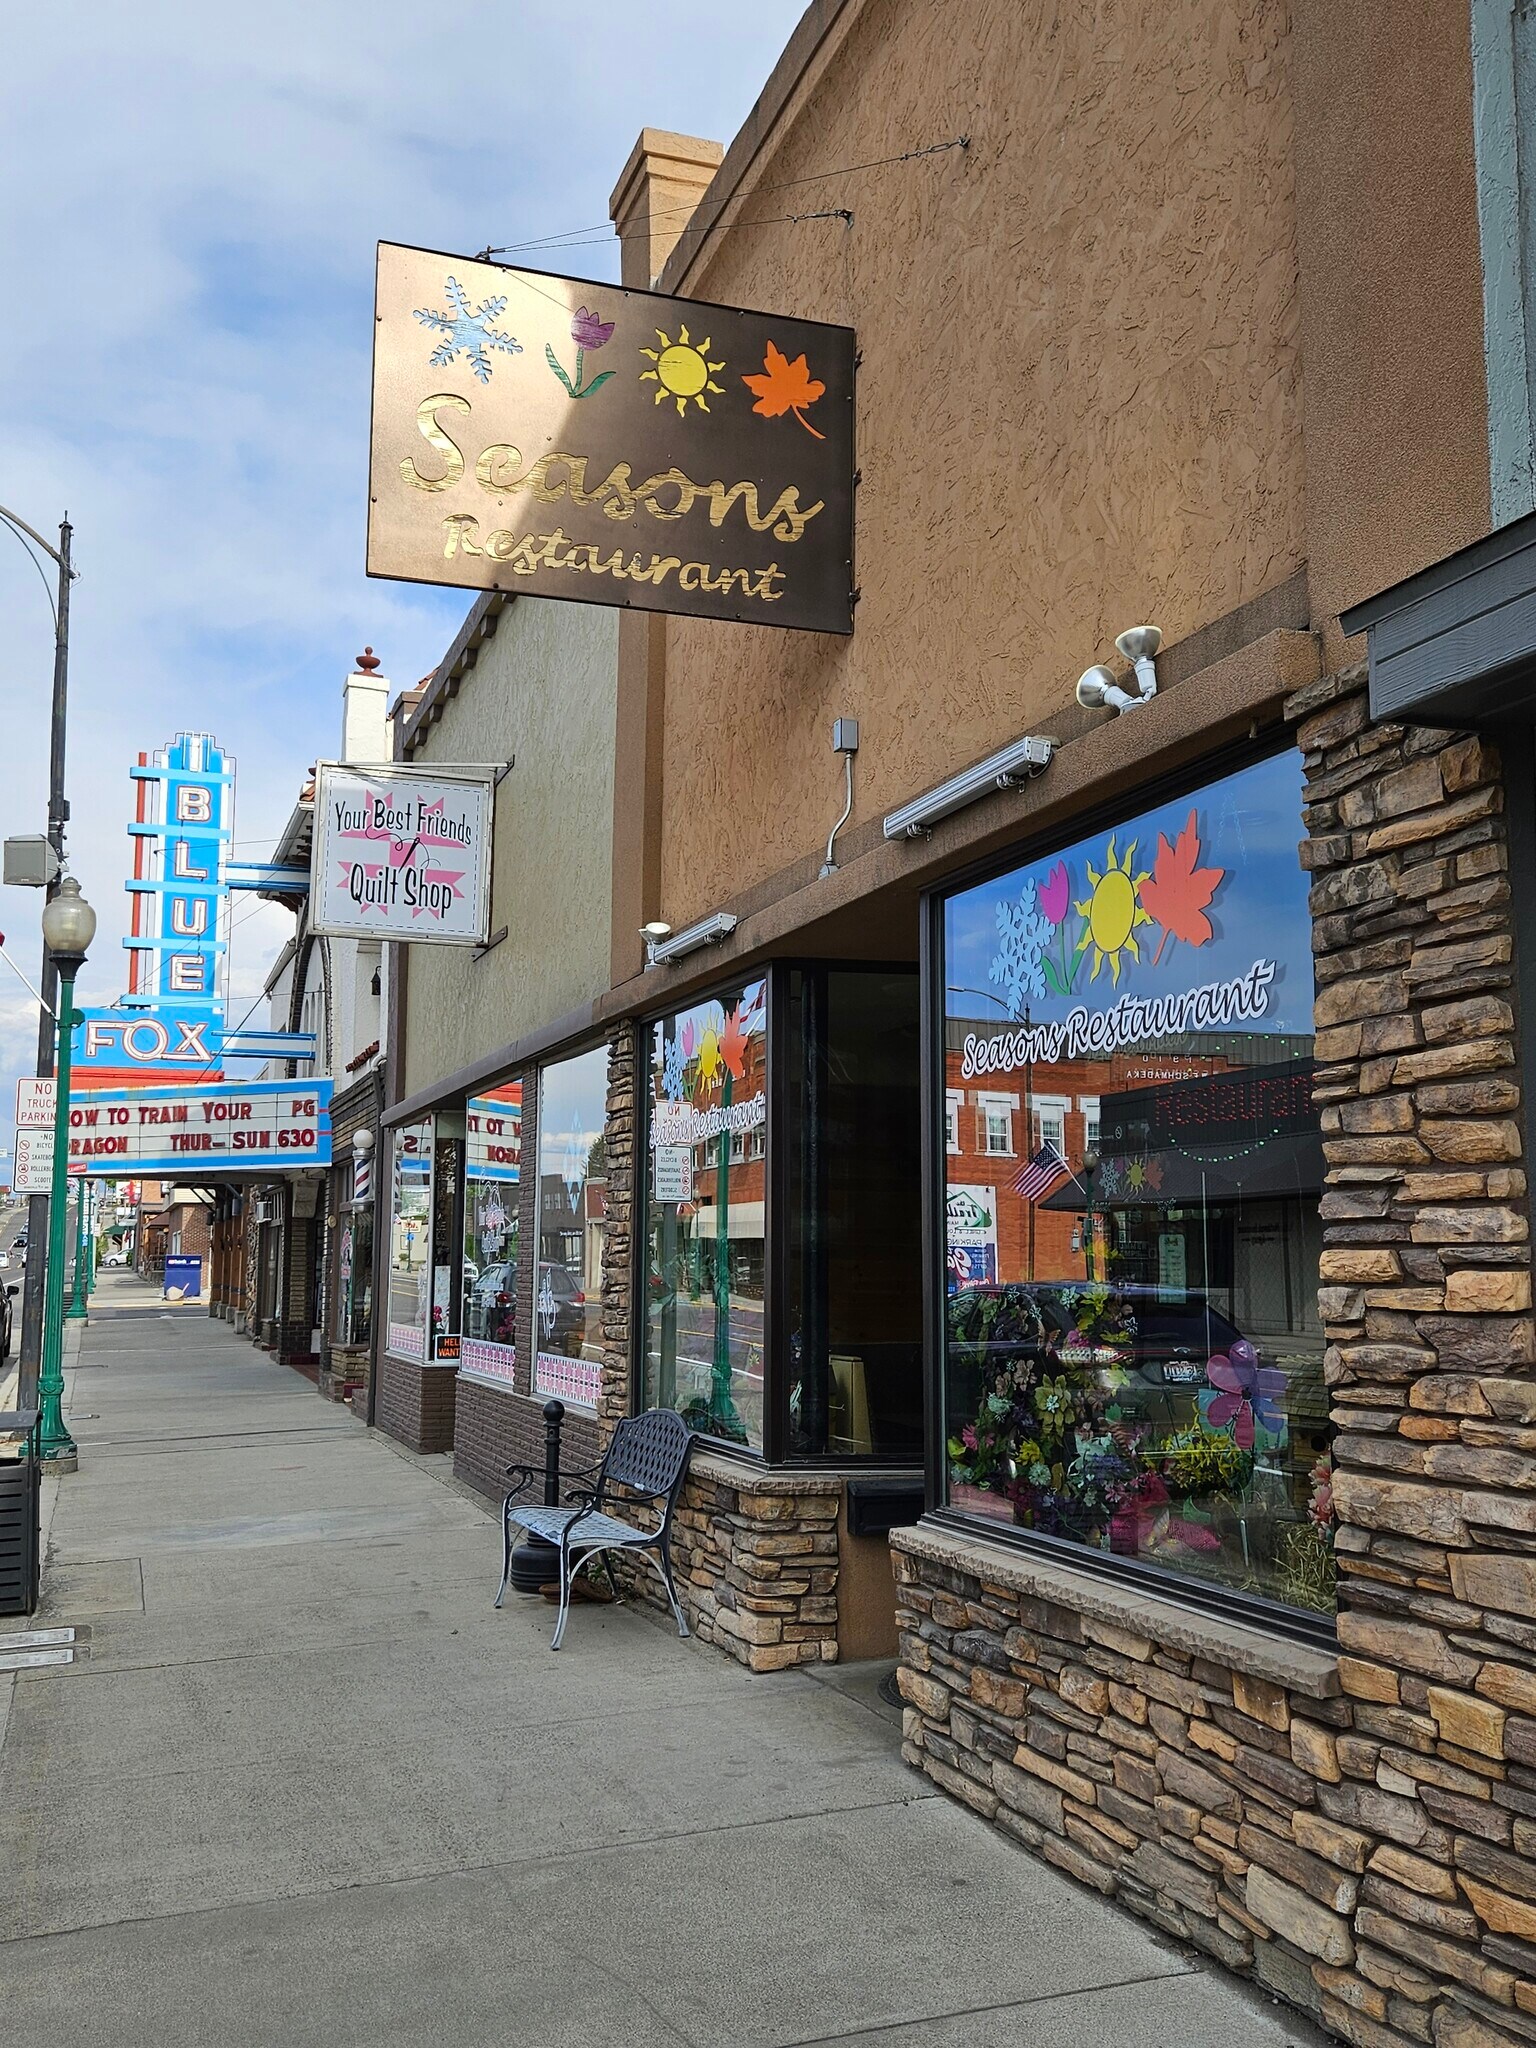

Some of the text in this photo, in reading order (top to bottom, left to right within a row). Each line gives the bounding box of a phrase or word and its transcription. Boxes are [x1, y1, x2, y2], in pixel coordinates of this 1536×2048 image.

[399, 393, 826, 543] Seasons
[441, 513, 788, 602] Restaurant
[335, 799, 471, 845] Your Best Friends
[170, 785, 211, 991] BLUE
[350, 863, 451, 918] Quilt Shop
[961, 958, 1276, 1080] Seasons Restaurant
[86, 1018, 213, 1062] FOX
[35, 1083, 52, 1095] NO
[21, 1111, 56, 1121] PARKIN
[69, 1099, 316, 1127] OW TO TRAIN YOUR PG
[43, 1133, 54, 1141] NO
[68, 1136, 128, 1155] RAGON
[232, 1130, 271, 1149] SUN
[277, 1128, 315, 1148] 630
[438, 1348, 460, 1357] WANT
[444, 1338, 461, 1346] HEL
